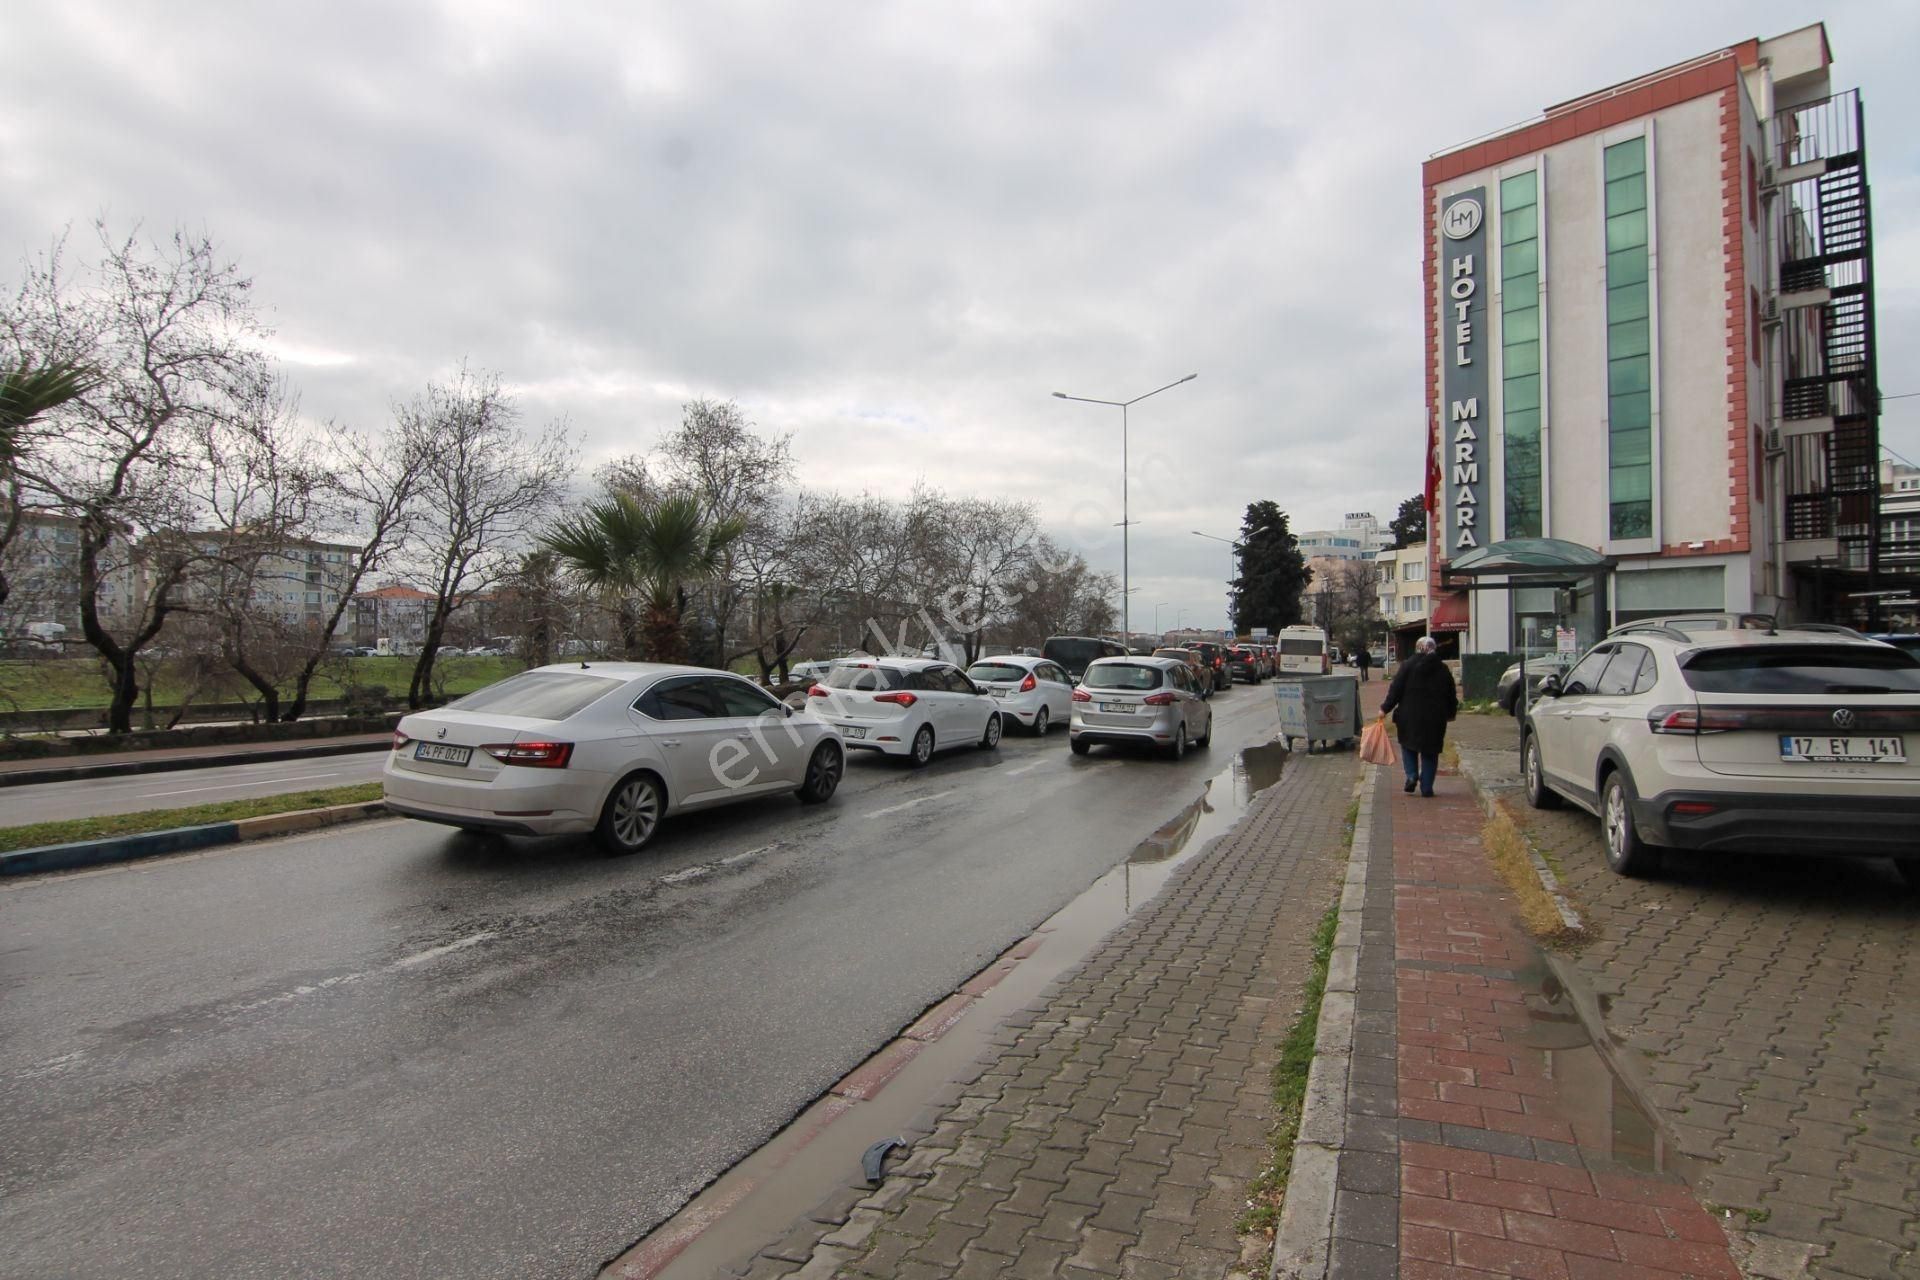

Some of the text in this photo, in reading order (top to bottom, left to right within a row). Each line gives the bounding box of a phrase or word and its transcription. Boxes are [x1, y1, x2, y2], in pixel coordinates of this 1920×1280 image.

[1451, 254, 1475, 366] HOTEL
[1452, 397, 1478, 549] MARMARA
[420, 744, 431, 757] 34
[432, 746, 445, 759] PF
[445, 748, 467, 762] 0211
[1795, 739, 1898, 755] 17 EY 141
